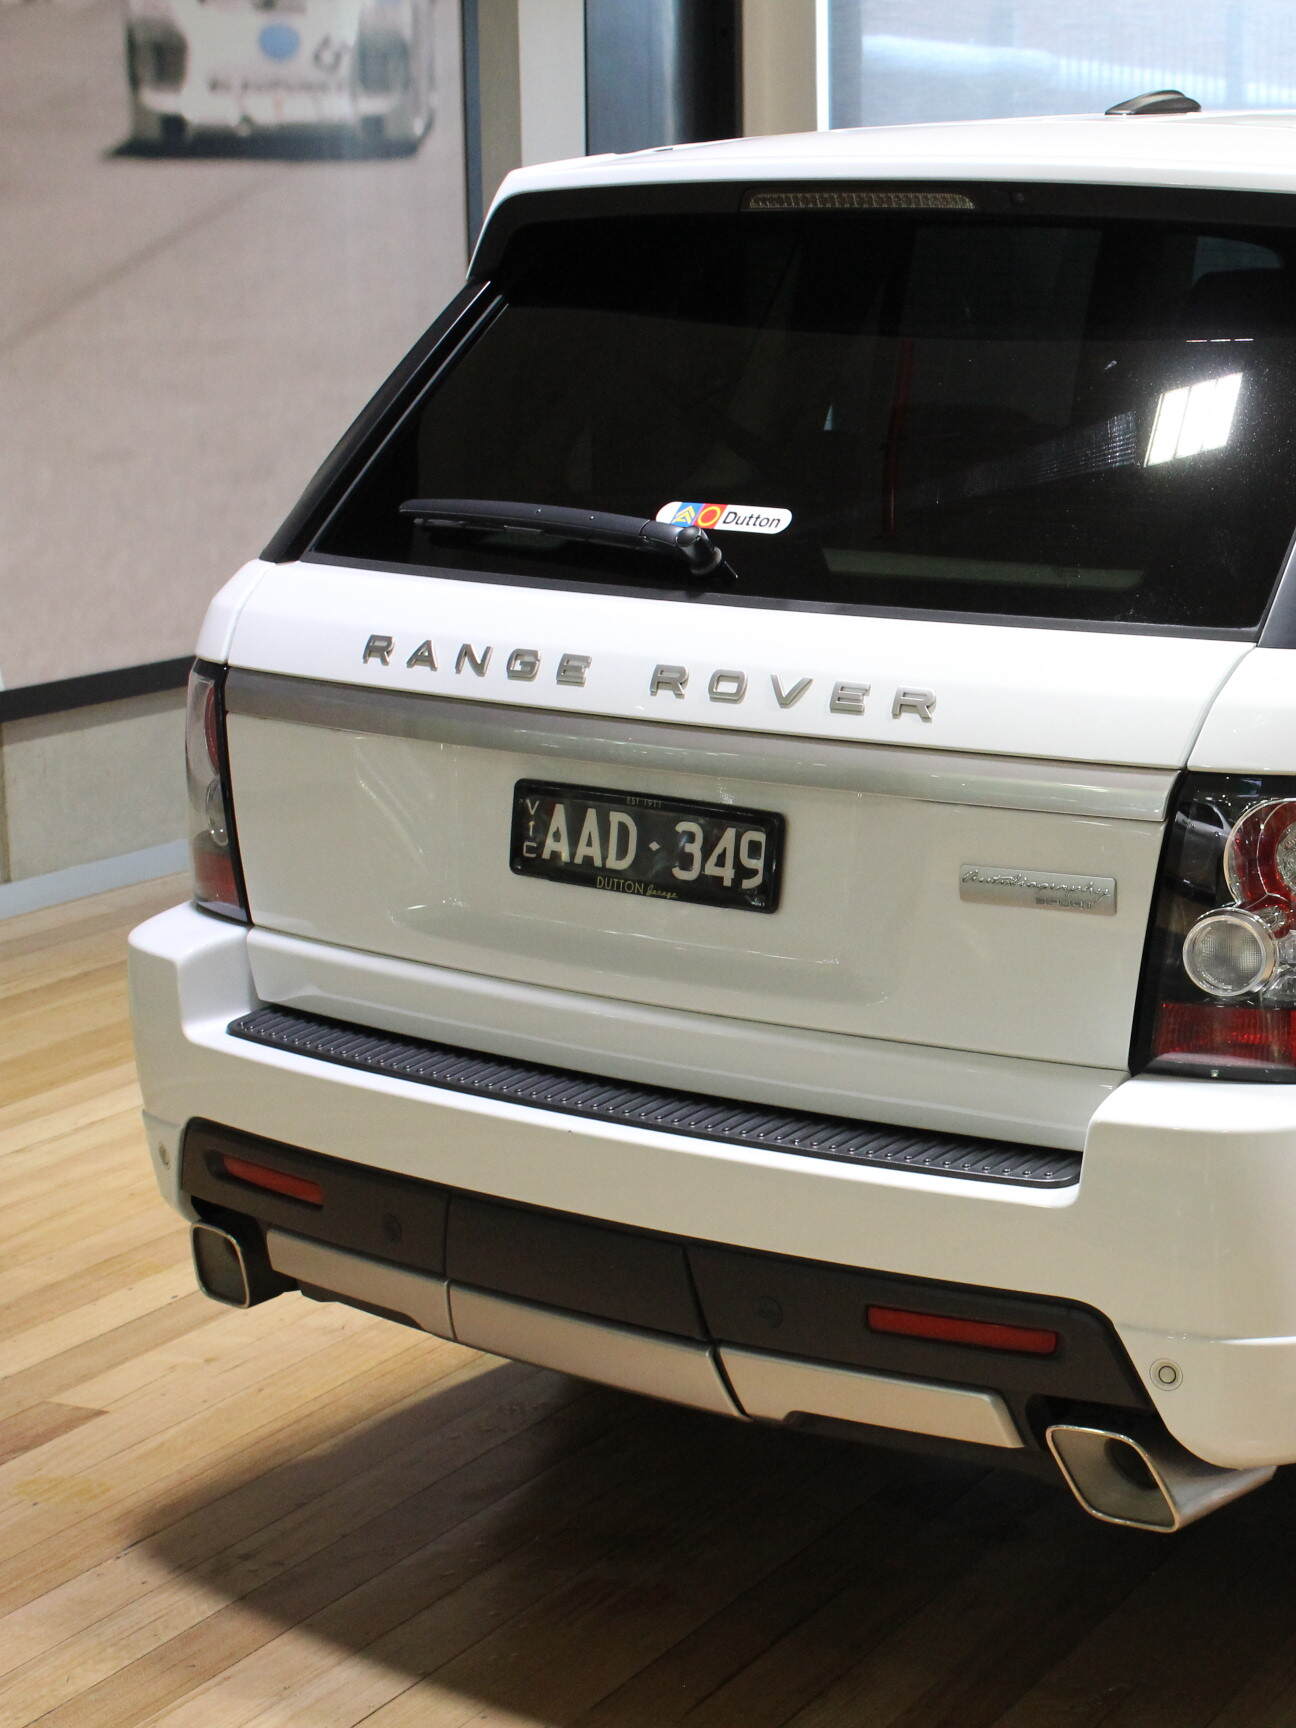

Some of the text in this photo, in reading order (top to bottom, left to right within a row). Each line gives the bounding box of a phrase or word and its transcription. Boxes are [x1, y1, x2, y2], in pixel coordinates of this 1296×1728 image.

[722, 511, 781, 529] Dutton
[362, 633, 937, 721] RANGE ROVER
[522, 799, 540, 858] VIC
[541, 803, 767, 890] AAD 349
[596, 875, 645, 895] DUTTON
